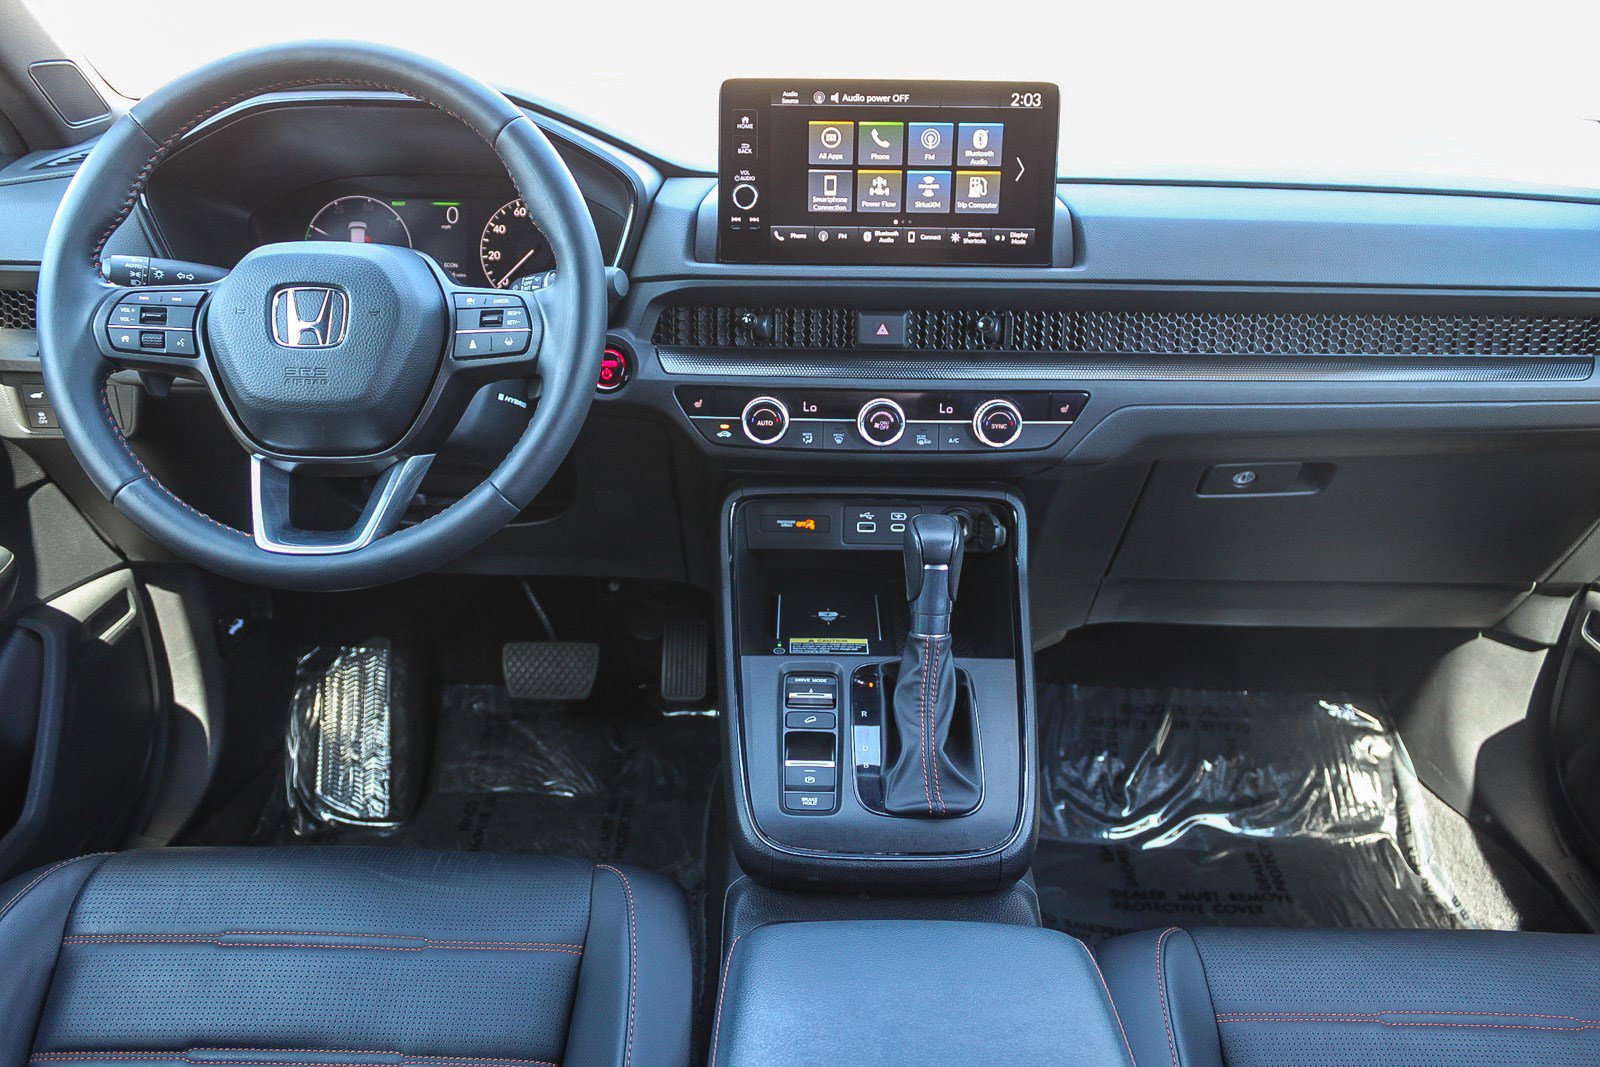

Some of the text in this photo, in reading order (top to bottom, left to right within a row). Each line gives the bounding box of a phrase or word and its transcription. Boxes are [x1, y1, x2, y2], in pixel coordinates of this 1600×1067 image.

[842, 94, 910, 104] Audio power OFF
[1010, 92, 1042, 108] 2:03
[446, 206, 458, 224] 0
[514, 207, 526, 216] 60
[493, 224, 506, 234] 40
[488, 251, 500, 260] 20
[285, 367, 328, 376] SRS
[504, 396, 527, 408] HYBRID
[803, 401, 818, 412] Lo
[939, 403, 954, 414] Lo
[1178, 890, 1218, 901] MUST
[1228, 891, 1294, 902] REMOVE
[1113, 902, 1265, 914] PROTECTIVE COVER
